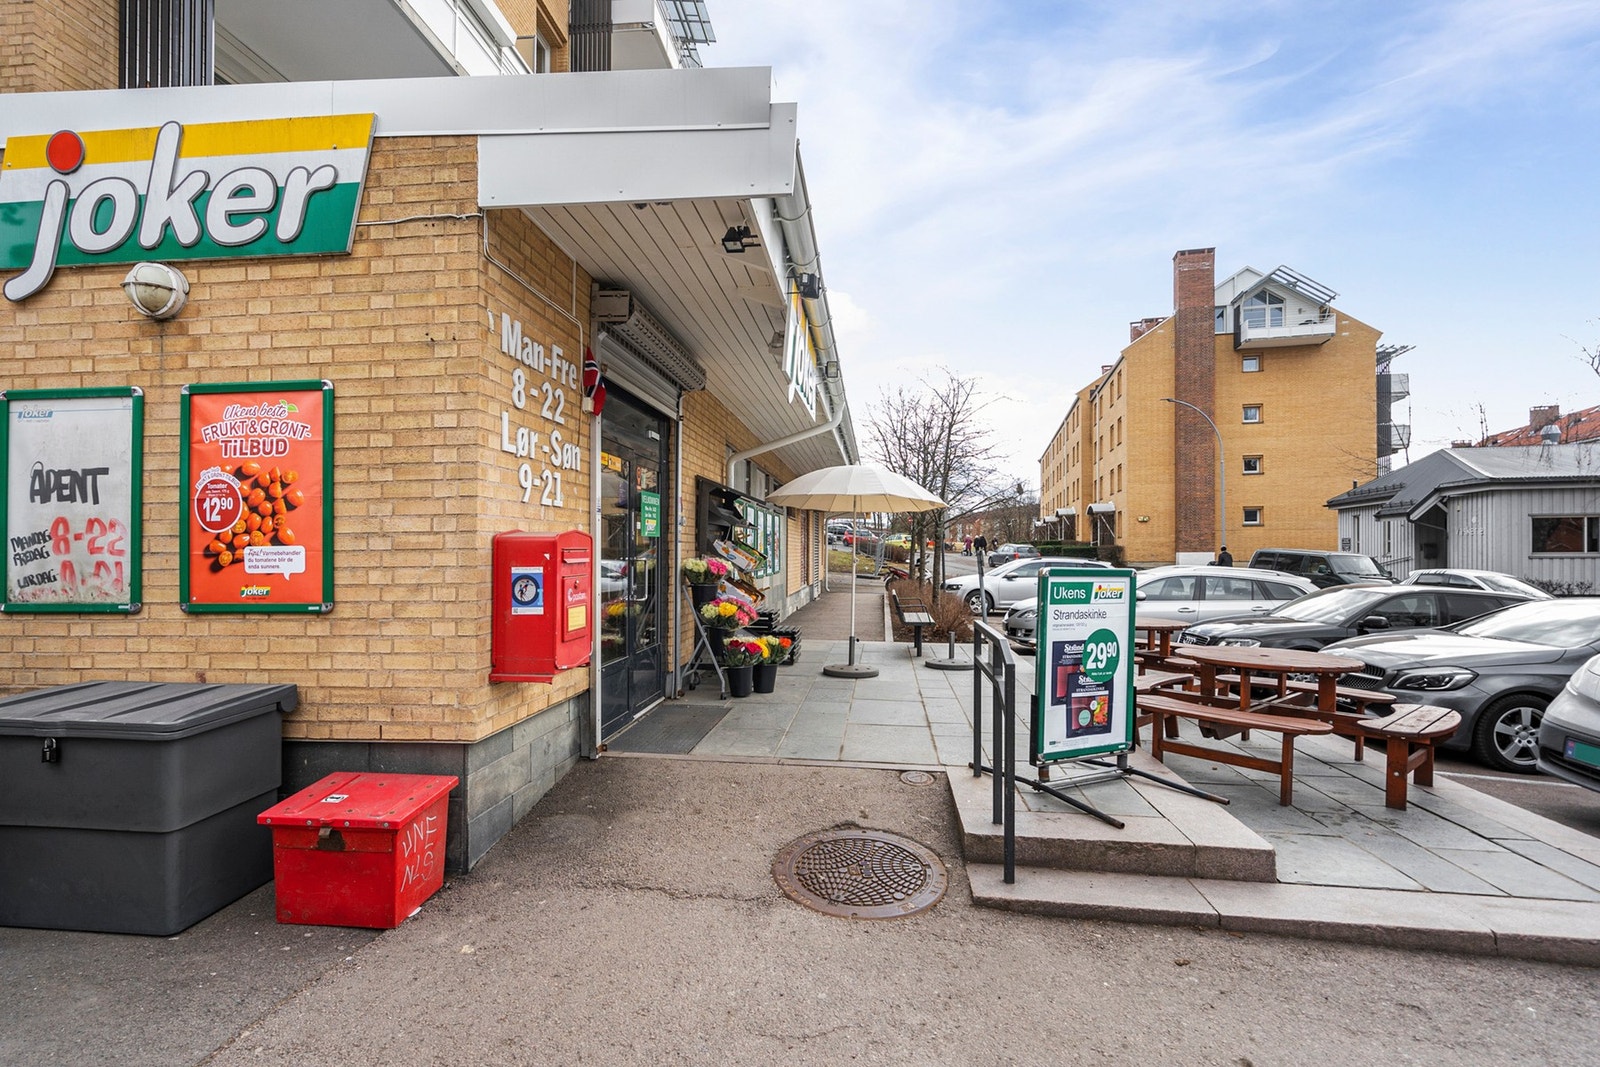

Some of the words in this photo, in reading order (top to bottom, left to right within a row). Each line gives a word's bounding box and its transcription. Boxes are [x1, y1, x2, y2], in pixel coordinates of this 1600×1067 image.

[3, 120, 338, 302] joker
[501, 312, 577, 390] Man-Fre
[18, 404, 51, 423] joker
[224, 404, 257, 420] Ukens
[260, 402, 288, 419] beste
[13, 545, 50, 567] FREDAG
[241, 585, 268, 598] joker
[1053, 586, 1086, 599] Ukens
[1095, 584, 1122, 600] joker
[1052, 609, 1107, 621] Strandaskinke
